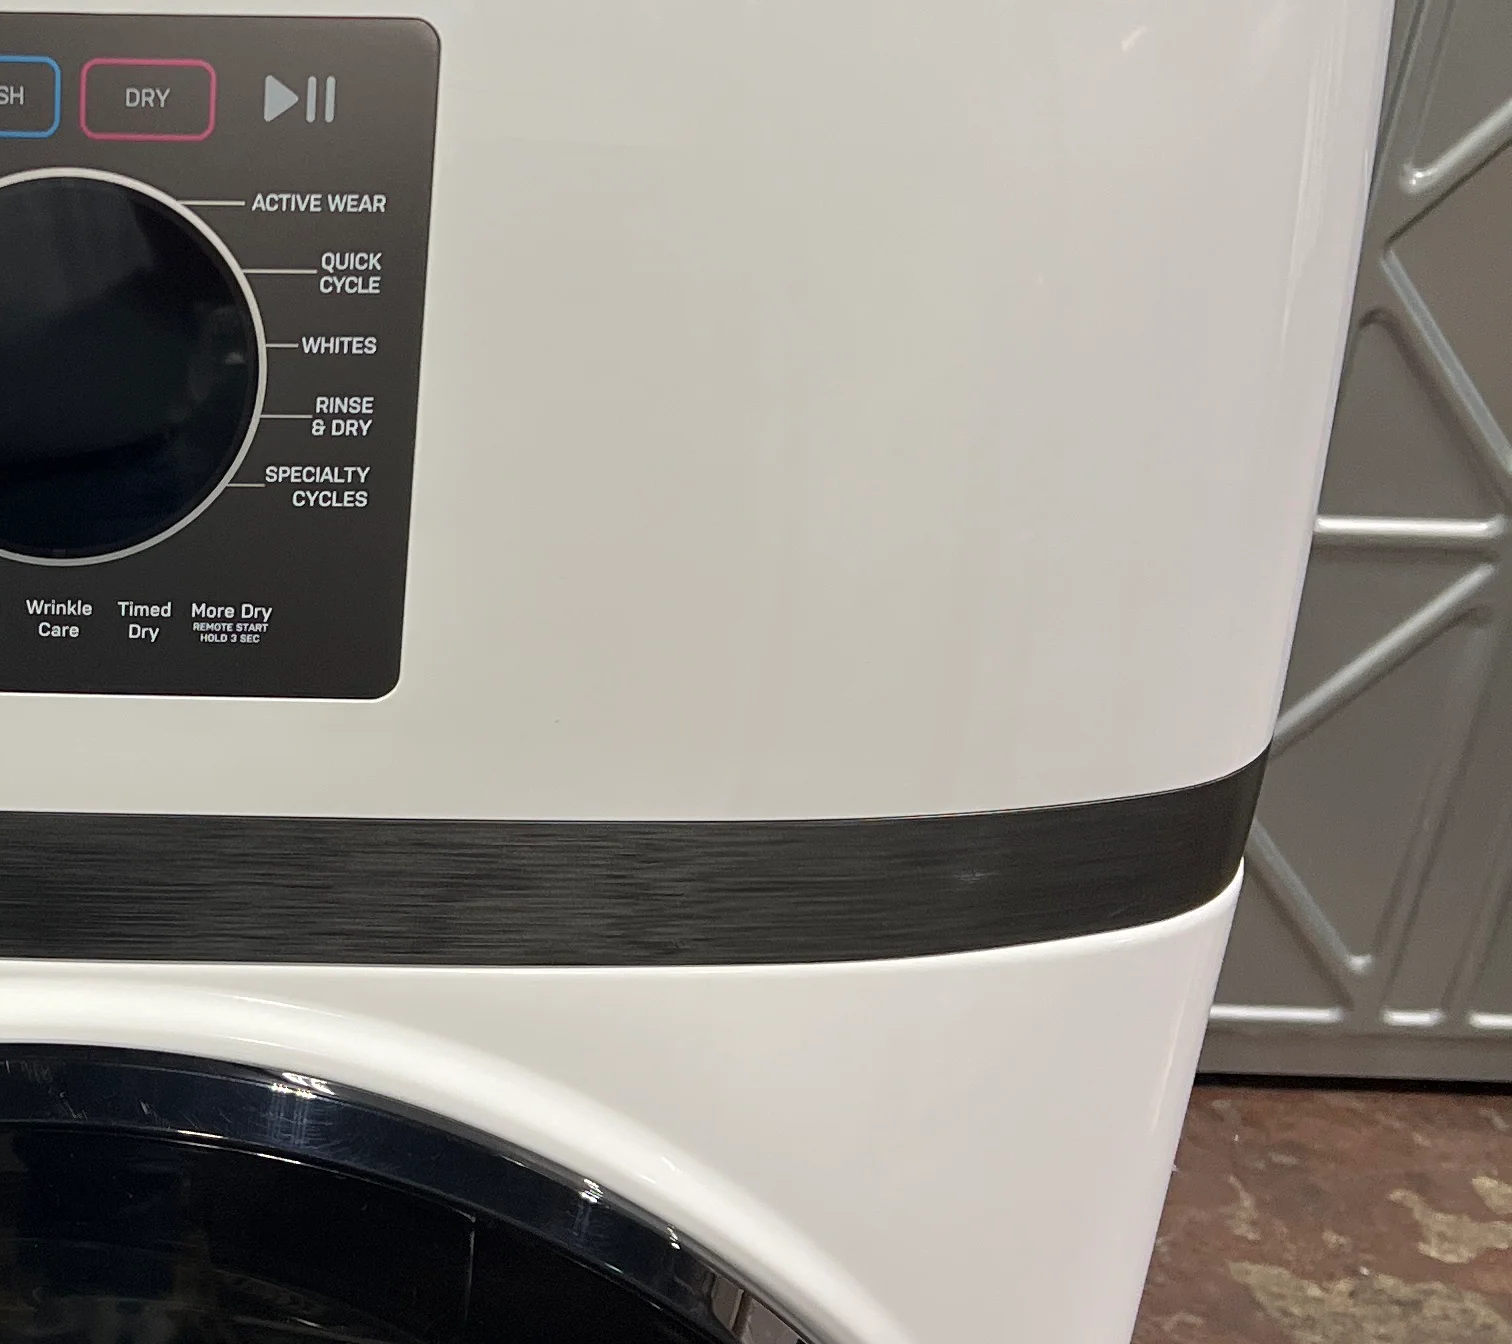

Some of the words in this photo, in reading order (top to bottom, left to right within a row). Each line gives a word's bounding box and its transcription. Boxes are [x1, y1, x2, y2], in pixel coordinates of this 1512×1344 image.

[124, 87, 171, 108] DRY
[251, 193, 323, 212] ACTIVE
[327, 193, 387, 213] WEAR
[320, 251, 382, 272] QUICK
[319, 275, 381, 295] CYCLE
[301, 336, 378, 354] WHITES
[315, 396, 375, 414] RINSE
[311, 419, 326, 436] &
[331, 419, 373, 436] DRY
[264, 465, 371, 484] SPECIALTY
[292, 490, 369, 507] CYCLES
[25, 599, 94, 616] Wrinkle
[116, 601, 172, 618] Timed
[190, 602, 236, 619] More
[240, 603, 273, 623] Dry
[37, 621, 80, 638] Care
[127, 623, 160, 643] Dry
[192, 622, 234, 633] REMOTE
[235, 622, 269, 633] START
[199, 632, 228, 644] HOLD
[230, 633, 238, 644] 3
[239, 633, 261, 644] SEC
